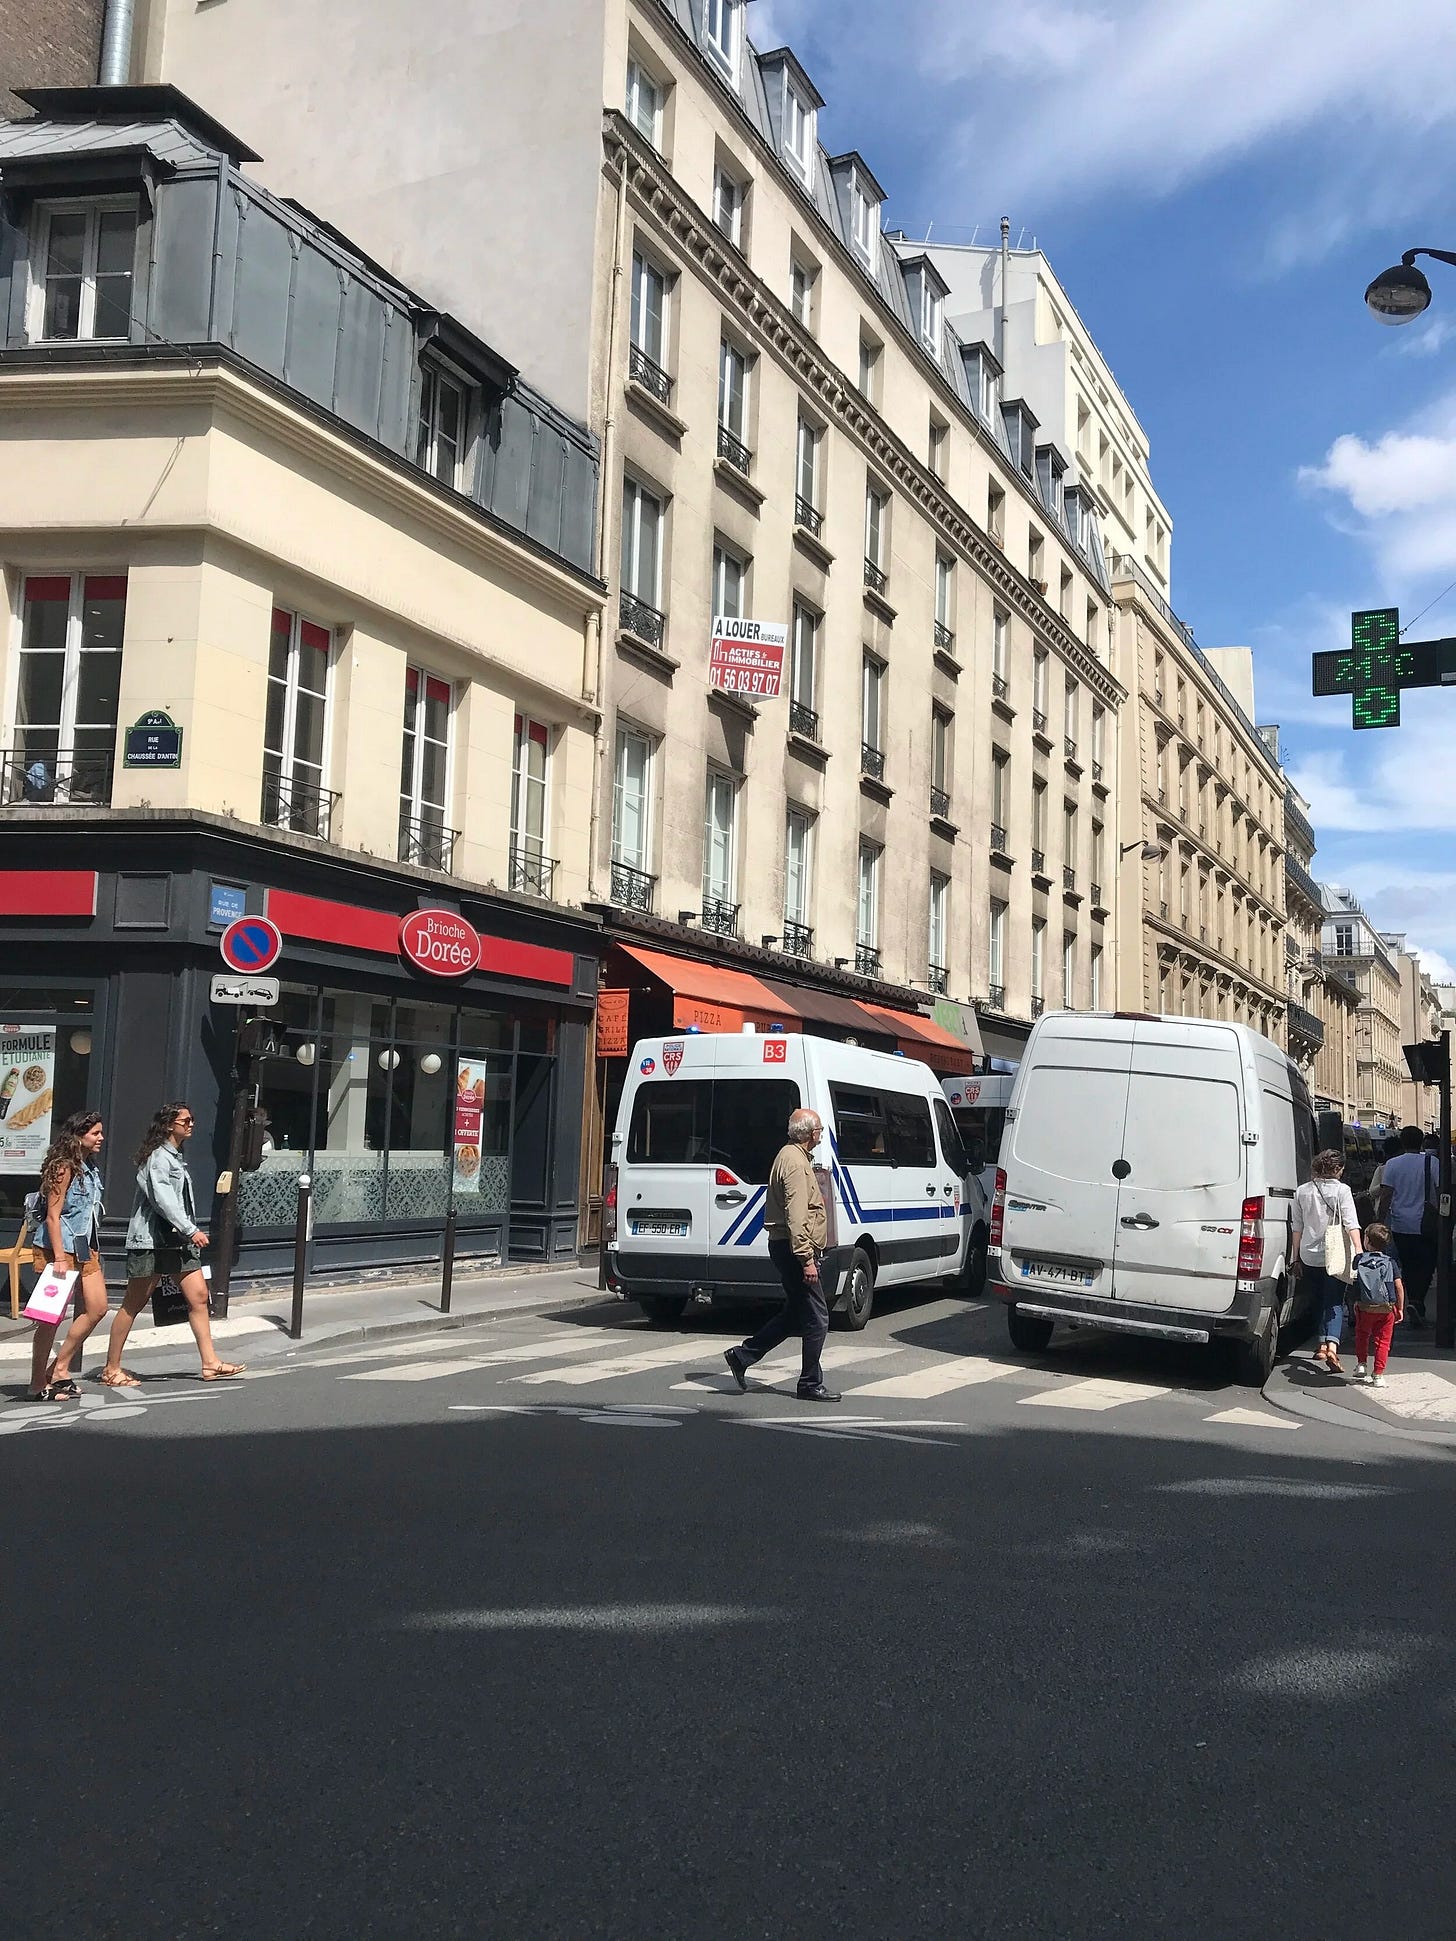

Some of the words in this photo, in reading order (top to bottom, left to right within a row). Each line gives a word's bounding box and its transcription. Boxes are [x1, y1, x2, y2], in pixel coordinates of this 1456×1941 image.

[715, 620, 722, 636] A
[726, 621, 760, 640] LOUER
[761, 633, 784, 643] BUREAUX
[729, 648, 760, 658] ACTIFS
[728, 655, 780, 669] IMMOBILIER
[710, 667, 721, 685] 01
[724, 668, 736, 688] 56
[738, 671, 750, 690] 03
[752, 672, 764, 692] 97
[766, 674, 778, 694] 07
[212, 907, 243, 918] PROVENCE
[427, 918, 466, 940] Brioche
[415, 930, 471, 966] Dorée
[694, 1010, 721, 1026] PIZZA
[2, 1034, 51, 1051] FORMULE
[765, 1044, 784, 1059] B3
[639, 1223, 680, 1234] EF-550-ER
[1029, 1264, 1085, 1282] AV-471-BT
